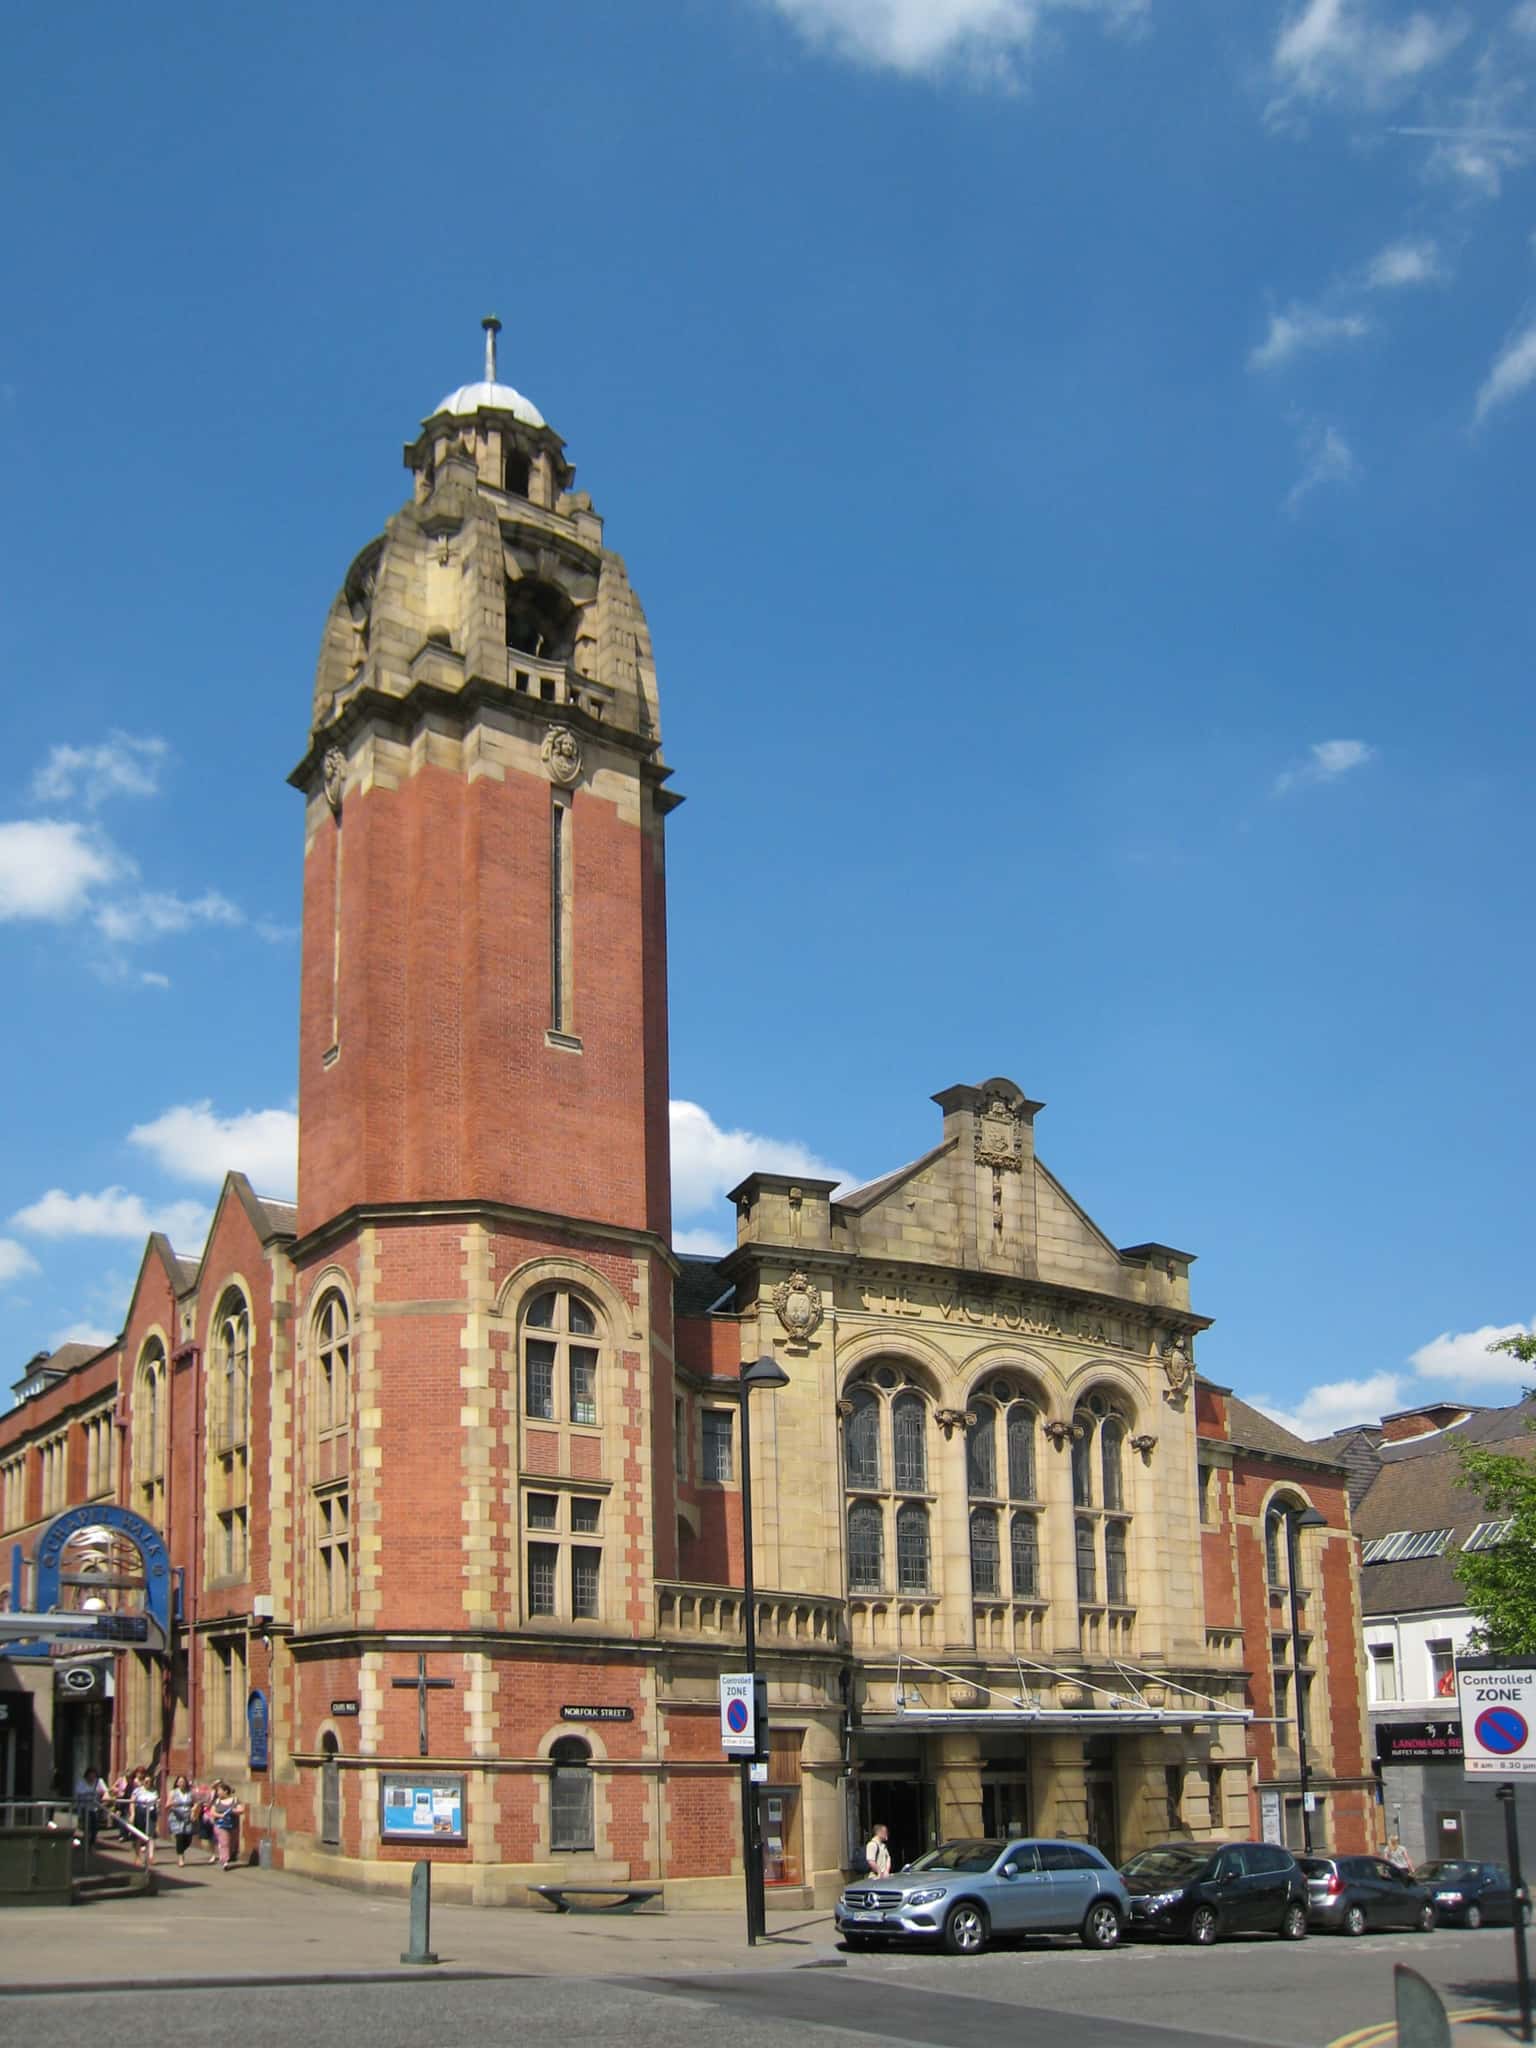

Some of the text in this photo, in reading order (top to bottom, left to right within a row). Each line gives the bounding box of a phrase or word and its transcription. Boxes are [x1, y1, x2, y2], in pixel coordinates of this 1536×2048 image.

[855, 1284, 1136, 1351] THE VICTORIA HALL
[1463, 1675, 1533, 1685] Controlled
[727, 1687, 748, 1696] ZONE
[1476, 1688, 1522, 1701] ZONE
[564, 1708, 599, 1716] NORFOLK
[1392, 1738, 1447, 1749] LANDMARK
